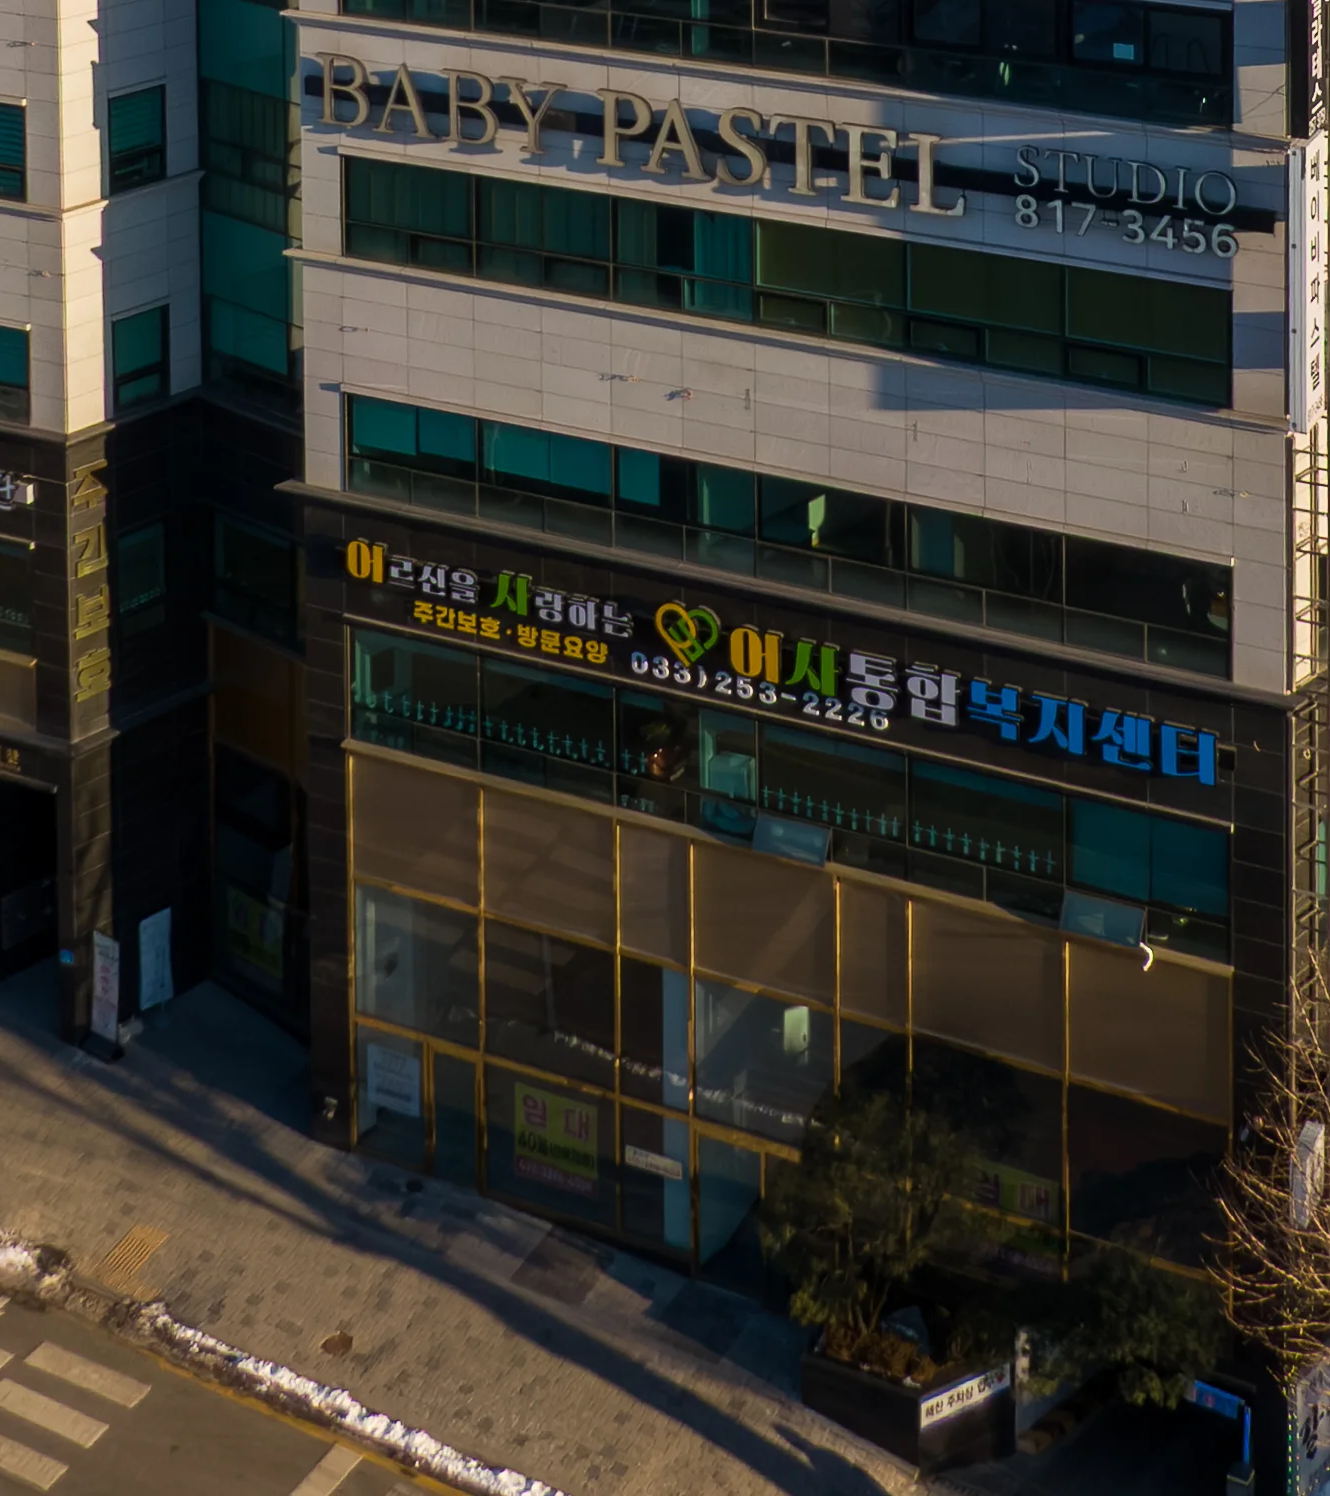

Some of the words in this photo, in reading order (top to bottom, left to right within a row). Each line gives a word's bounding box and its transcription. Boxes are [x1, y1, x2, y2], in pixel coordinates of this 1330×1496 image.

[315, 51, 568, 155] BABY
[595, 87, 967, 216] PASTEL
[1013, 144, 1239, 216] STUDIO
[489, 570, 634, 639] 사랑하는
